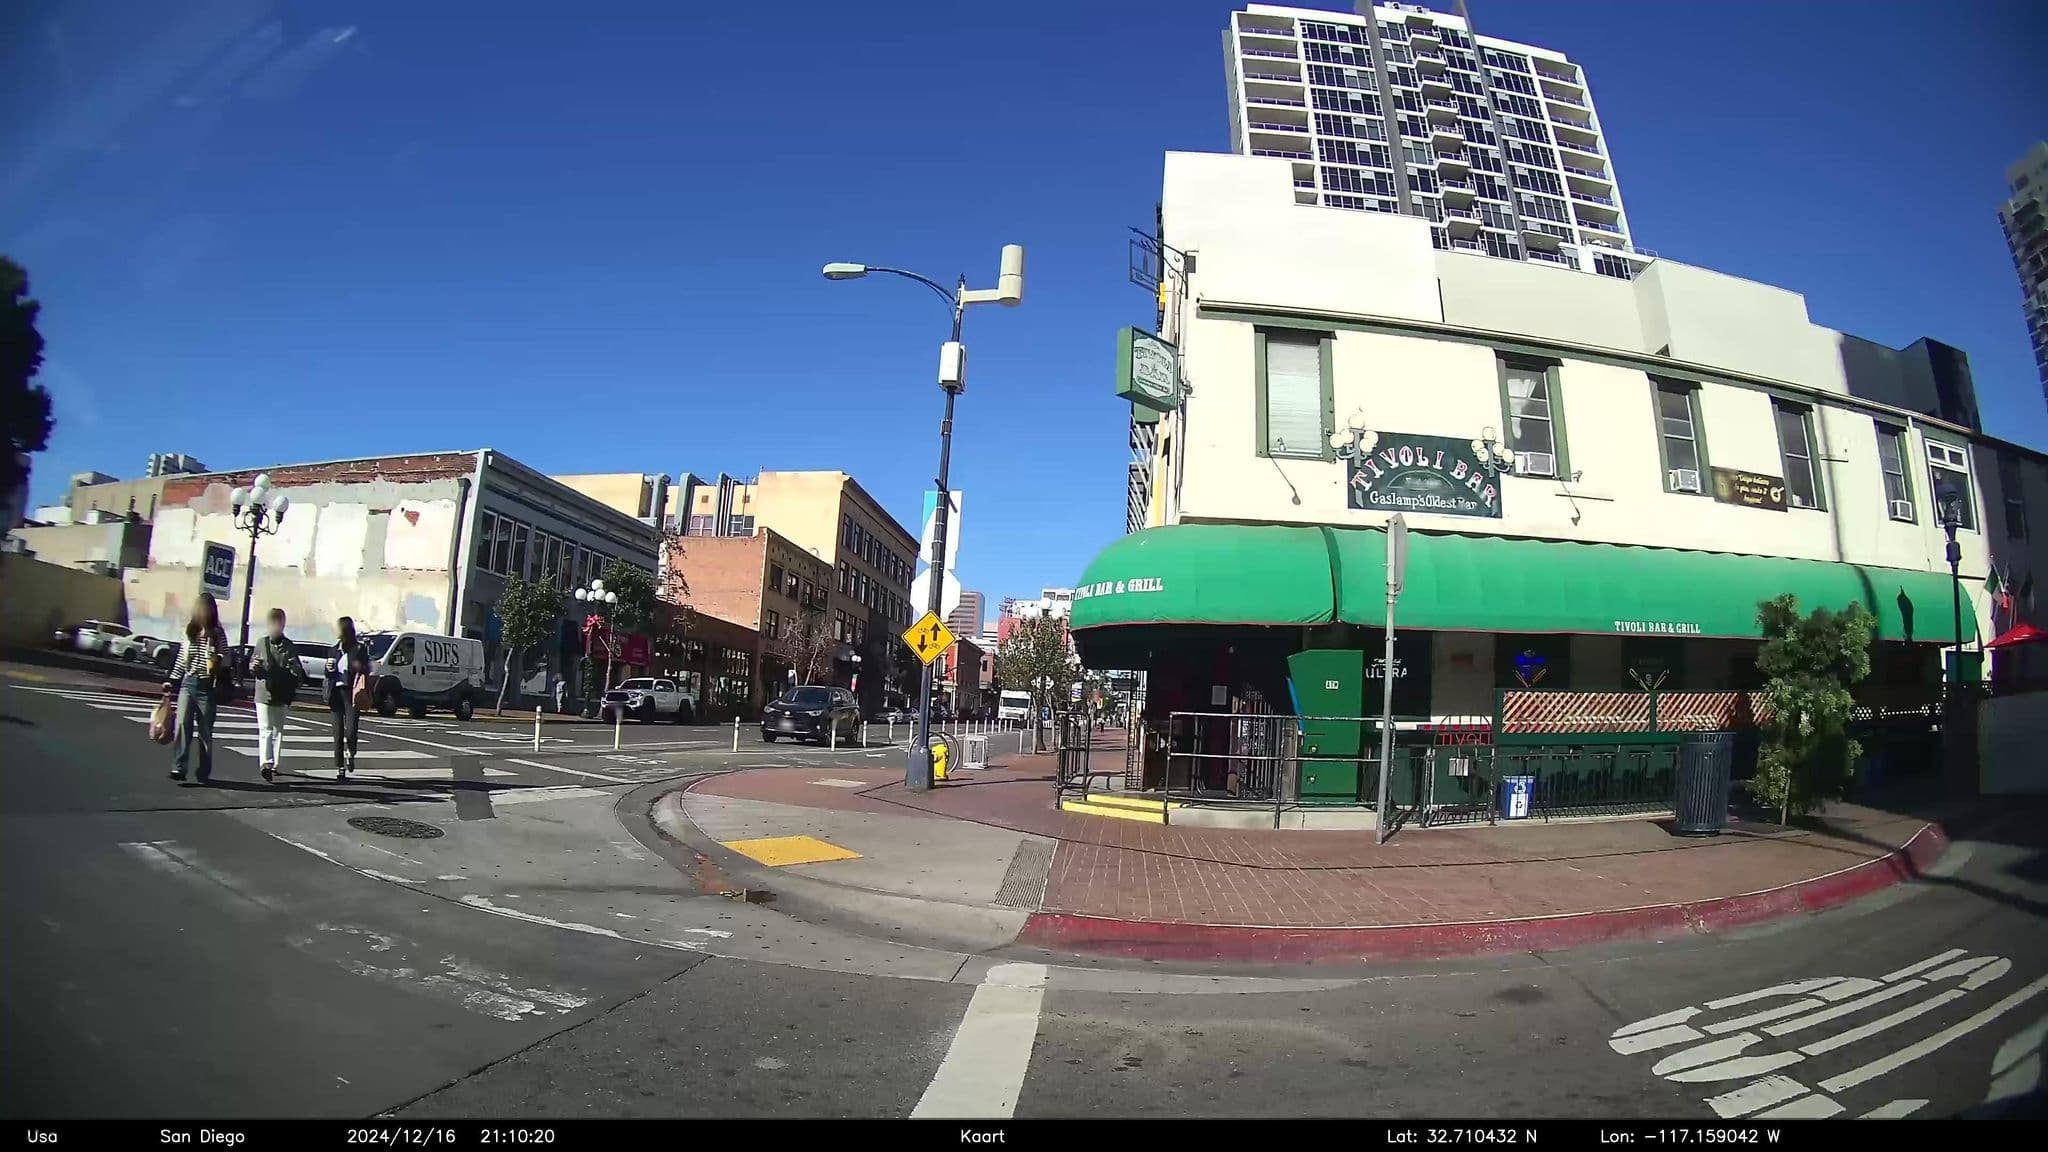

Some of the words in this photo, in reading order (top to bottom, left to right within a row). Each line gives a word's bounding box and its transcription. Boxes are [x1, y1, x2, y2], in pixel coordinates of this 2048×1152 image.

[1350, 445, 1444, 491] TIVOLI
[1450, 459, 1497, 508] BAR
[1369, 490, 1425, 509] Gaslamp's
[1425, 494, 1456, 509] Oldest
[205, 555, 231, 578] ACE
[1115, 580, 1125, 593] &
[1128, 577, 1164, 592] GRILL
[1614, 620, 1646, 632] TIVOLI
[1648, 621, 1667, 632] BAR
[1667, 623, 1675, 633] &
[1676, 623, 1701, 634] GRILL
[424, 639, 459, 666] SDFS
[1439, 732, 1490, 746] TIVOLI
